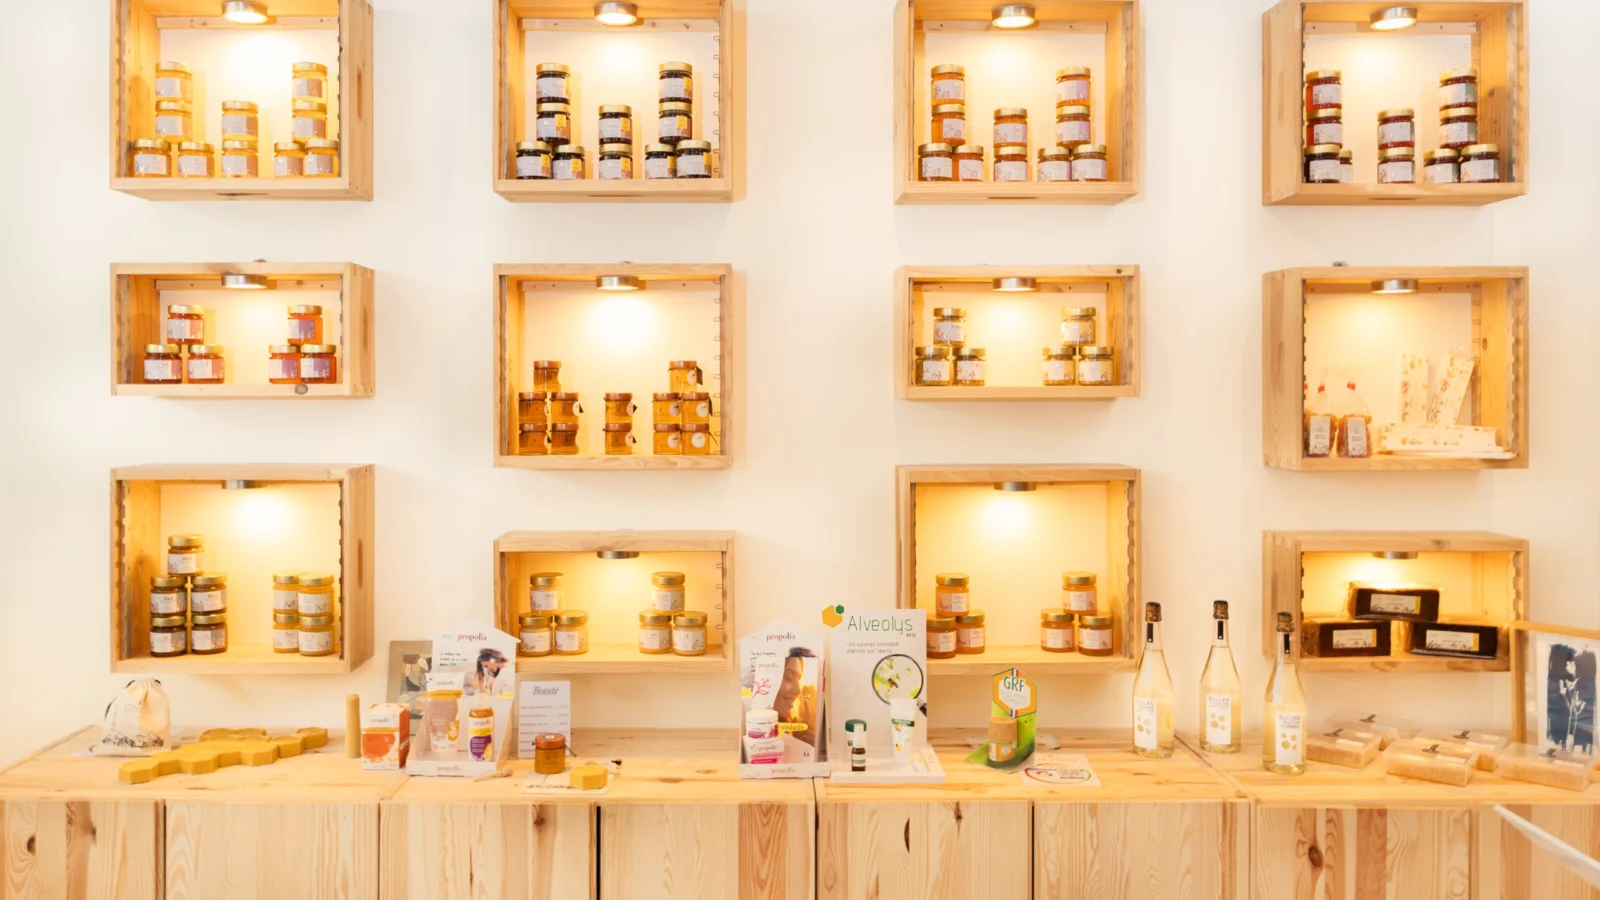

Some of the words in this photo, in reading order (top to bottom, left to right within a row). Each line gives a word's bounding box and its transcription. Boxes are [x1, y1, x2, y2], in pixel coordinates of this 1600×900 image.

[847, 615, 913, 635] Alveolys
[457, 632, 487, 642] propolia
[766, 632, 796, 642] propolia
[1003, 675, 1025, 692] GRF
[533, 685, 560, 695] Beauté
